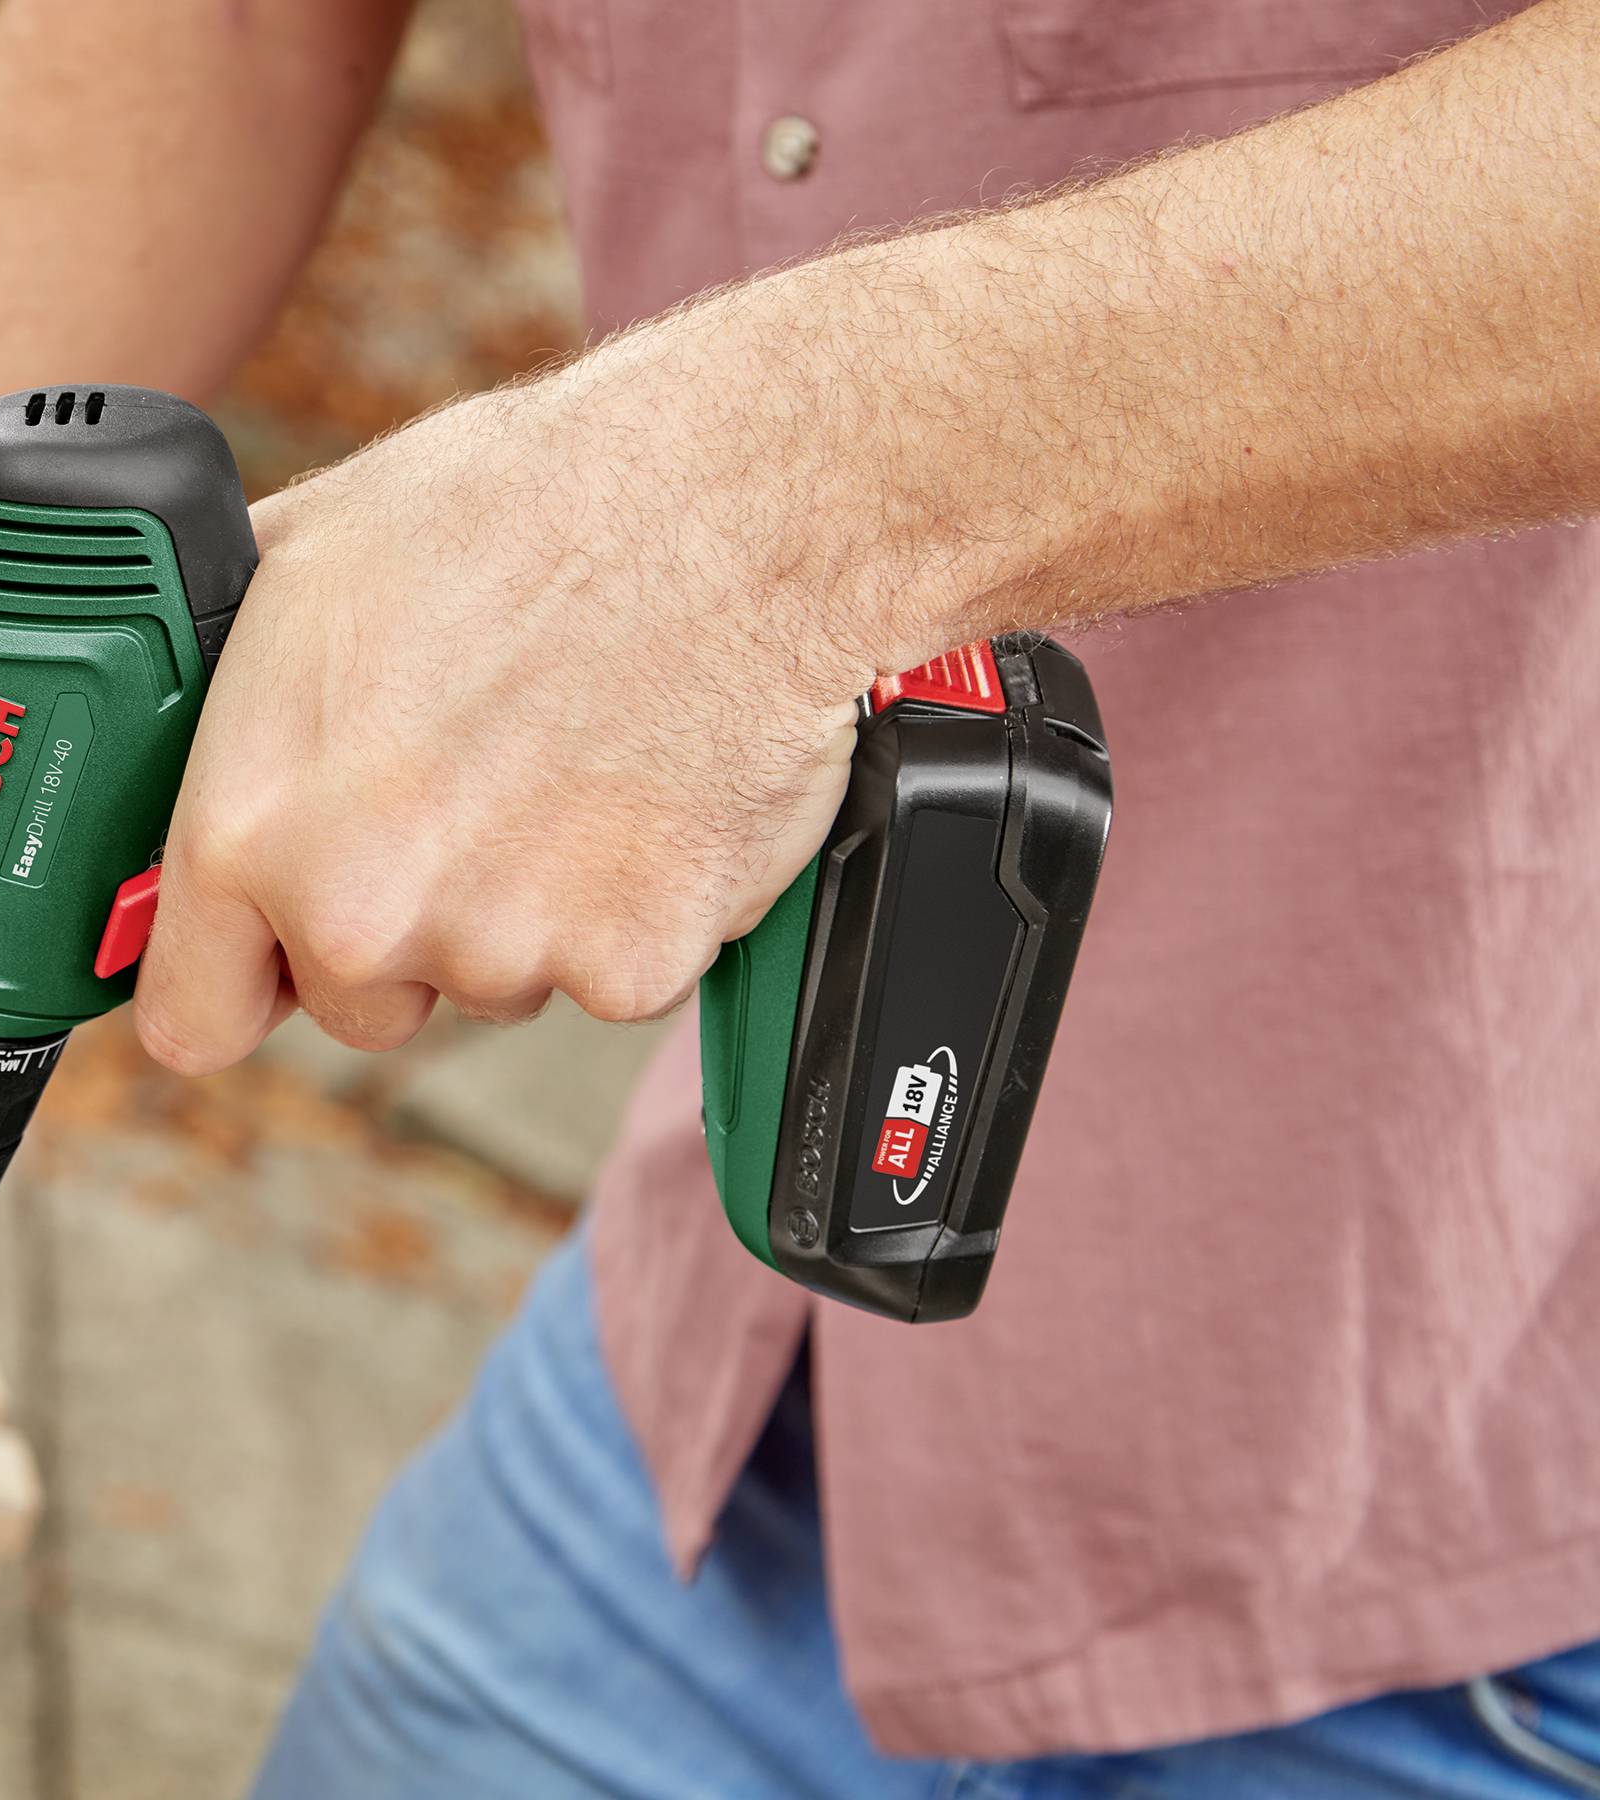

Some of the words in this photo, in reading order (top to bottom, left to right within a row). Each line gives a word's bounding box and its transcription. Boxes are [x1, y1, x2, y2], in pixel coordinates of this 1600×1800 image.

[12, 800, 53, 878] EasyDrill
[41, 739, 72, 794] 18V-40
[797, 1076, 831, 1198] BOSCH
[877, 1142, 888, 1165] POWER
[883, 1130, 891, 1142] FOR
[887, 1128, 915, 1169] ALL
[902, 1075, 927, 1114] 18V
[929, 1095, 957, 1166] ALLIANCE
